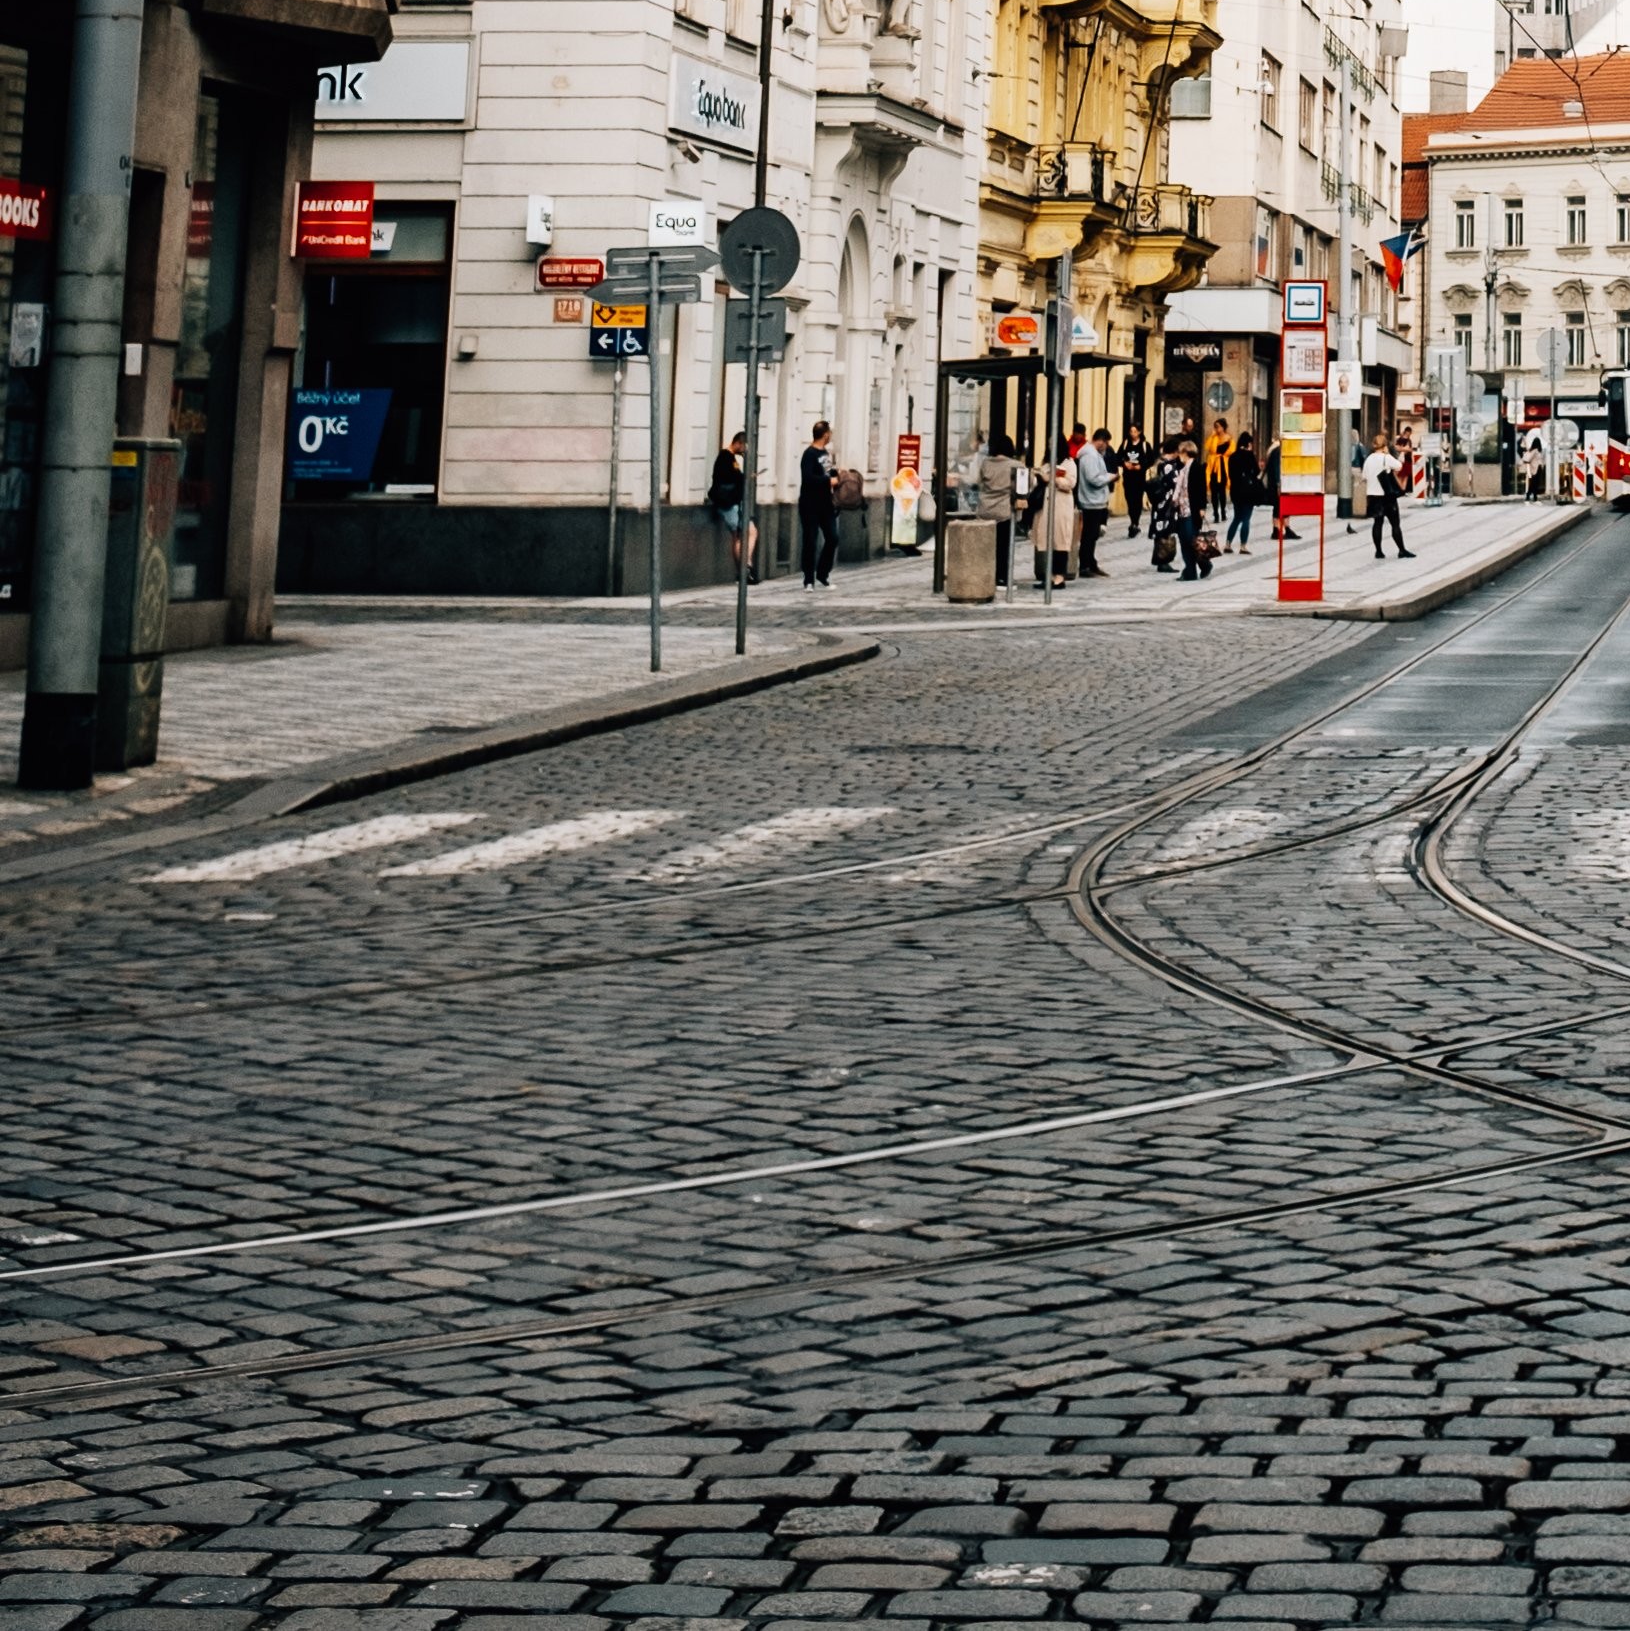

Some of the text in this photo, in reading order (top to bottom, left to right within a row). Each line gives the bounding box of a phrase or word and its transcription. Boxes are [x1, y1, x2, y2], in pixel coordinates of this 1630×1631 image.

[302, 199, 369, 212] BANKOMAT
[656, 213, 697, 230] Equa
[308, 235, 367, 246] UniCredit Bank
[299, 415, 349, 453] 0 Kč
